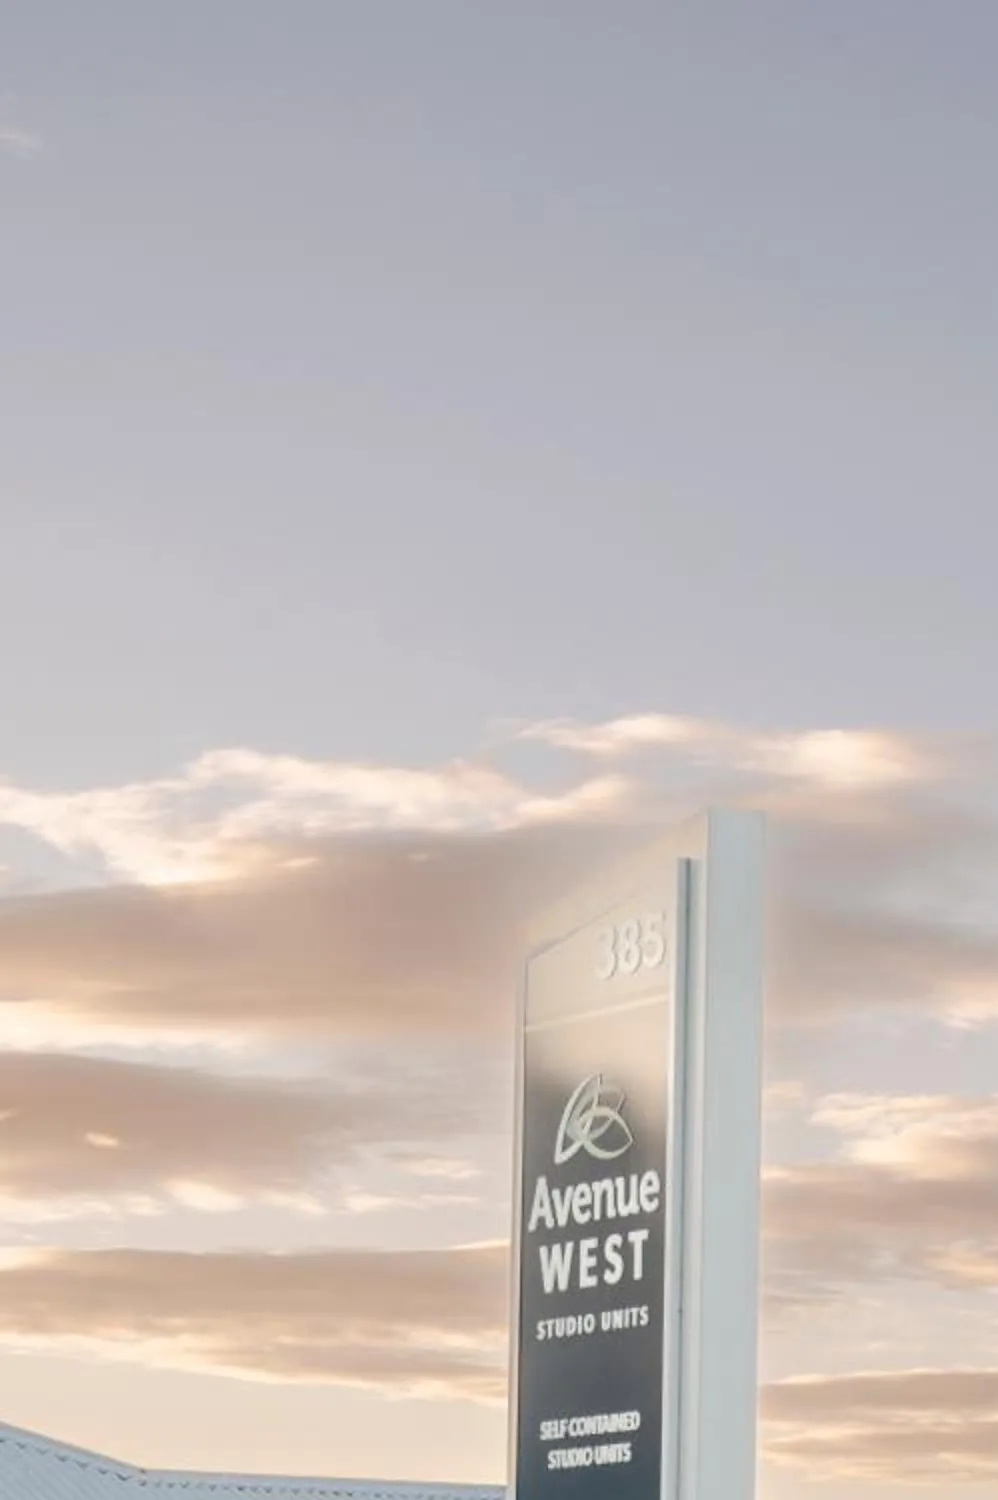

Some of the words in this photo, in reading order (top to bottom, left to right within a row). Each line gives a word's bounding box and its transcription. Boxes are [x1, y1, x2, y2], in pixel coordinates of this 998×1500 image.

[597, 912, 667, 979] 385
[528, 1169, 660, 1231] Avenue
[539, 1230, 649, 1294] WEST
[536, 1313, 596, 1341] STUDIO
[601, 1305, 649, 1332] UNITS
[548, 1447, 592, 1469] STUDIO
[594, 1443, 632, 1465] UNITS
